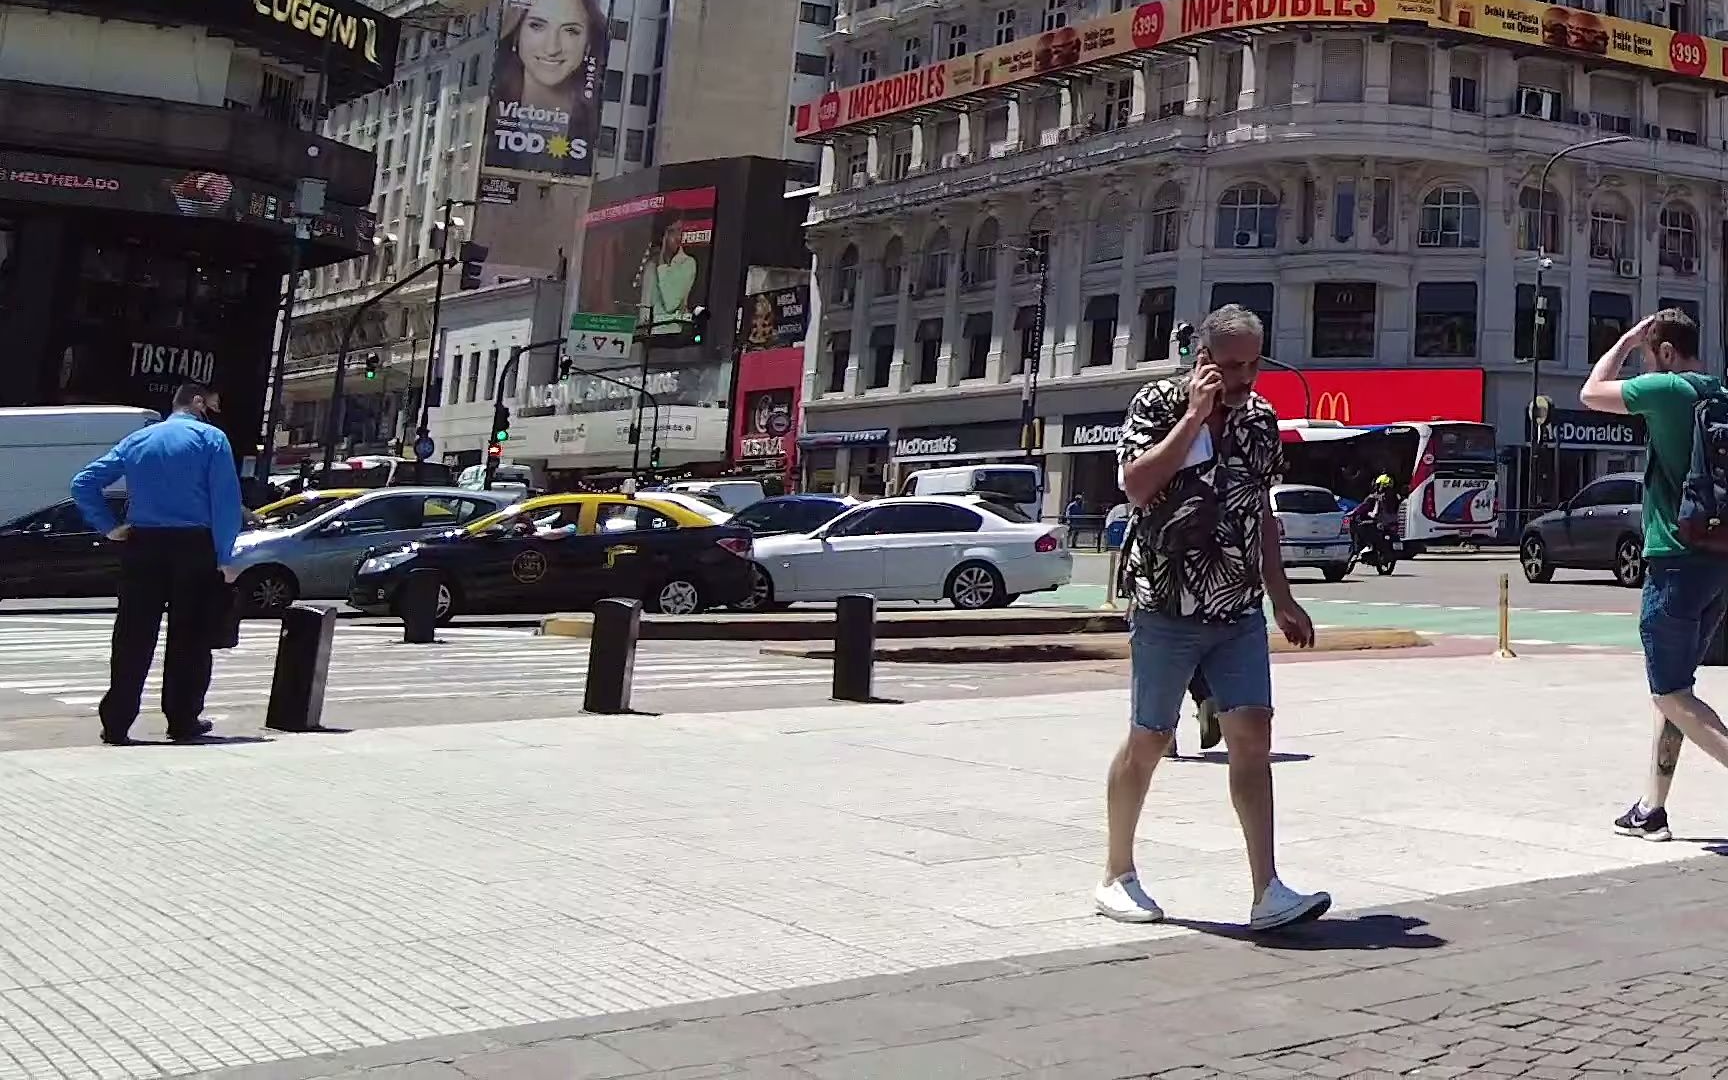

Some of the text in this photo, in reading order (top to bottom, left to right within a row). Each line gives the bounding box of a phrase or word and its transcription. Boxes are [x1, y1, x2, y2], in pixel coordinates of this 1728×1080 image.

[1132, 13, 1159, 37] $399
[1671, 42, 1700, 65] $399
[847, 63, 946, 121] IMPERDIBLES
[499, 100, 569, 125] Victoria
[130, 341, 214, 385] TOSTADO
[896, 434, 958, 456] McDonald's
